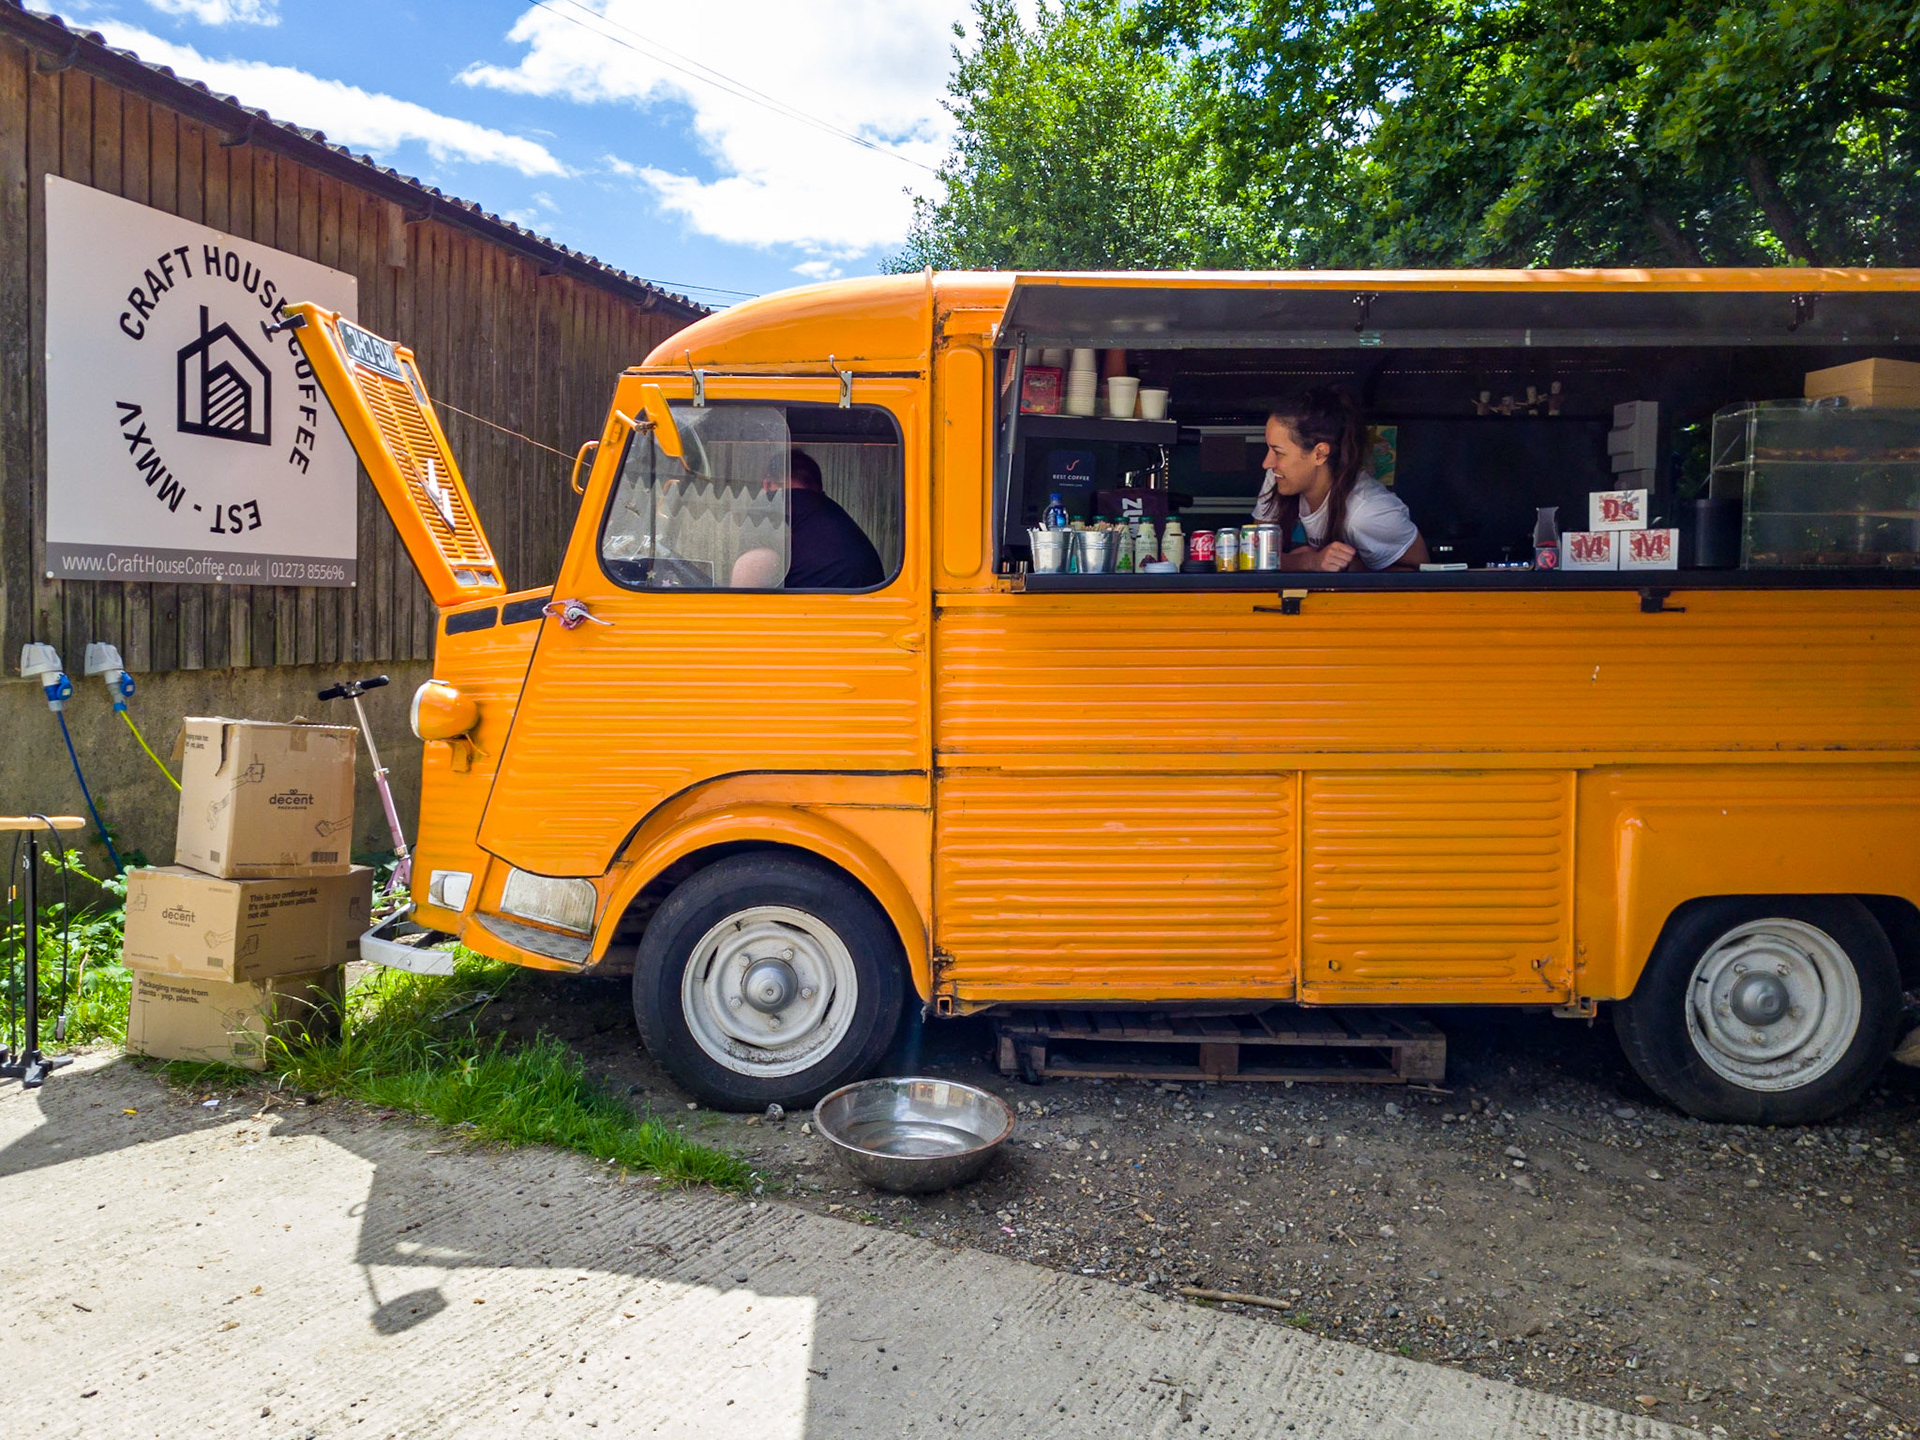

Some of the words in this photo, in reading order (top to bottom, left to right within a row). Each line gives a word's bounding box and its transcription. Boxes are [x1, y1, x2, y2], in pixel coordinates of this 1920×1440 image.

[119, 245, 192, 341] CRAFT
[116, 401, 186, 513] MMXV
[210, 499, 262, 534] EST
[62, 553, 261, 577] www.CraftHouseCoffee.co.uk
[271, 562, 305, 578] 01273
[307, 565, 345, 580] 855696
[269, 794, 314, 805] decent
[250, 894, 263, 902] This
[282, 889, 308, 898] ordinary
[259, 901, 278, 909] made
[162, 908, 195, 923] decent
[138, 989, 156, 997] plants
[139, 978, 170, 993] Packaging
[170, 986, 189, 994] made
[191, 988, 208, 997] from
